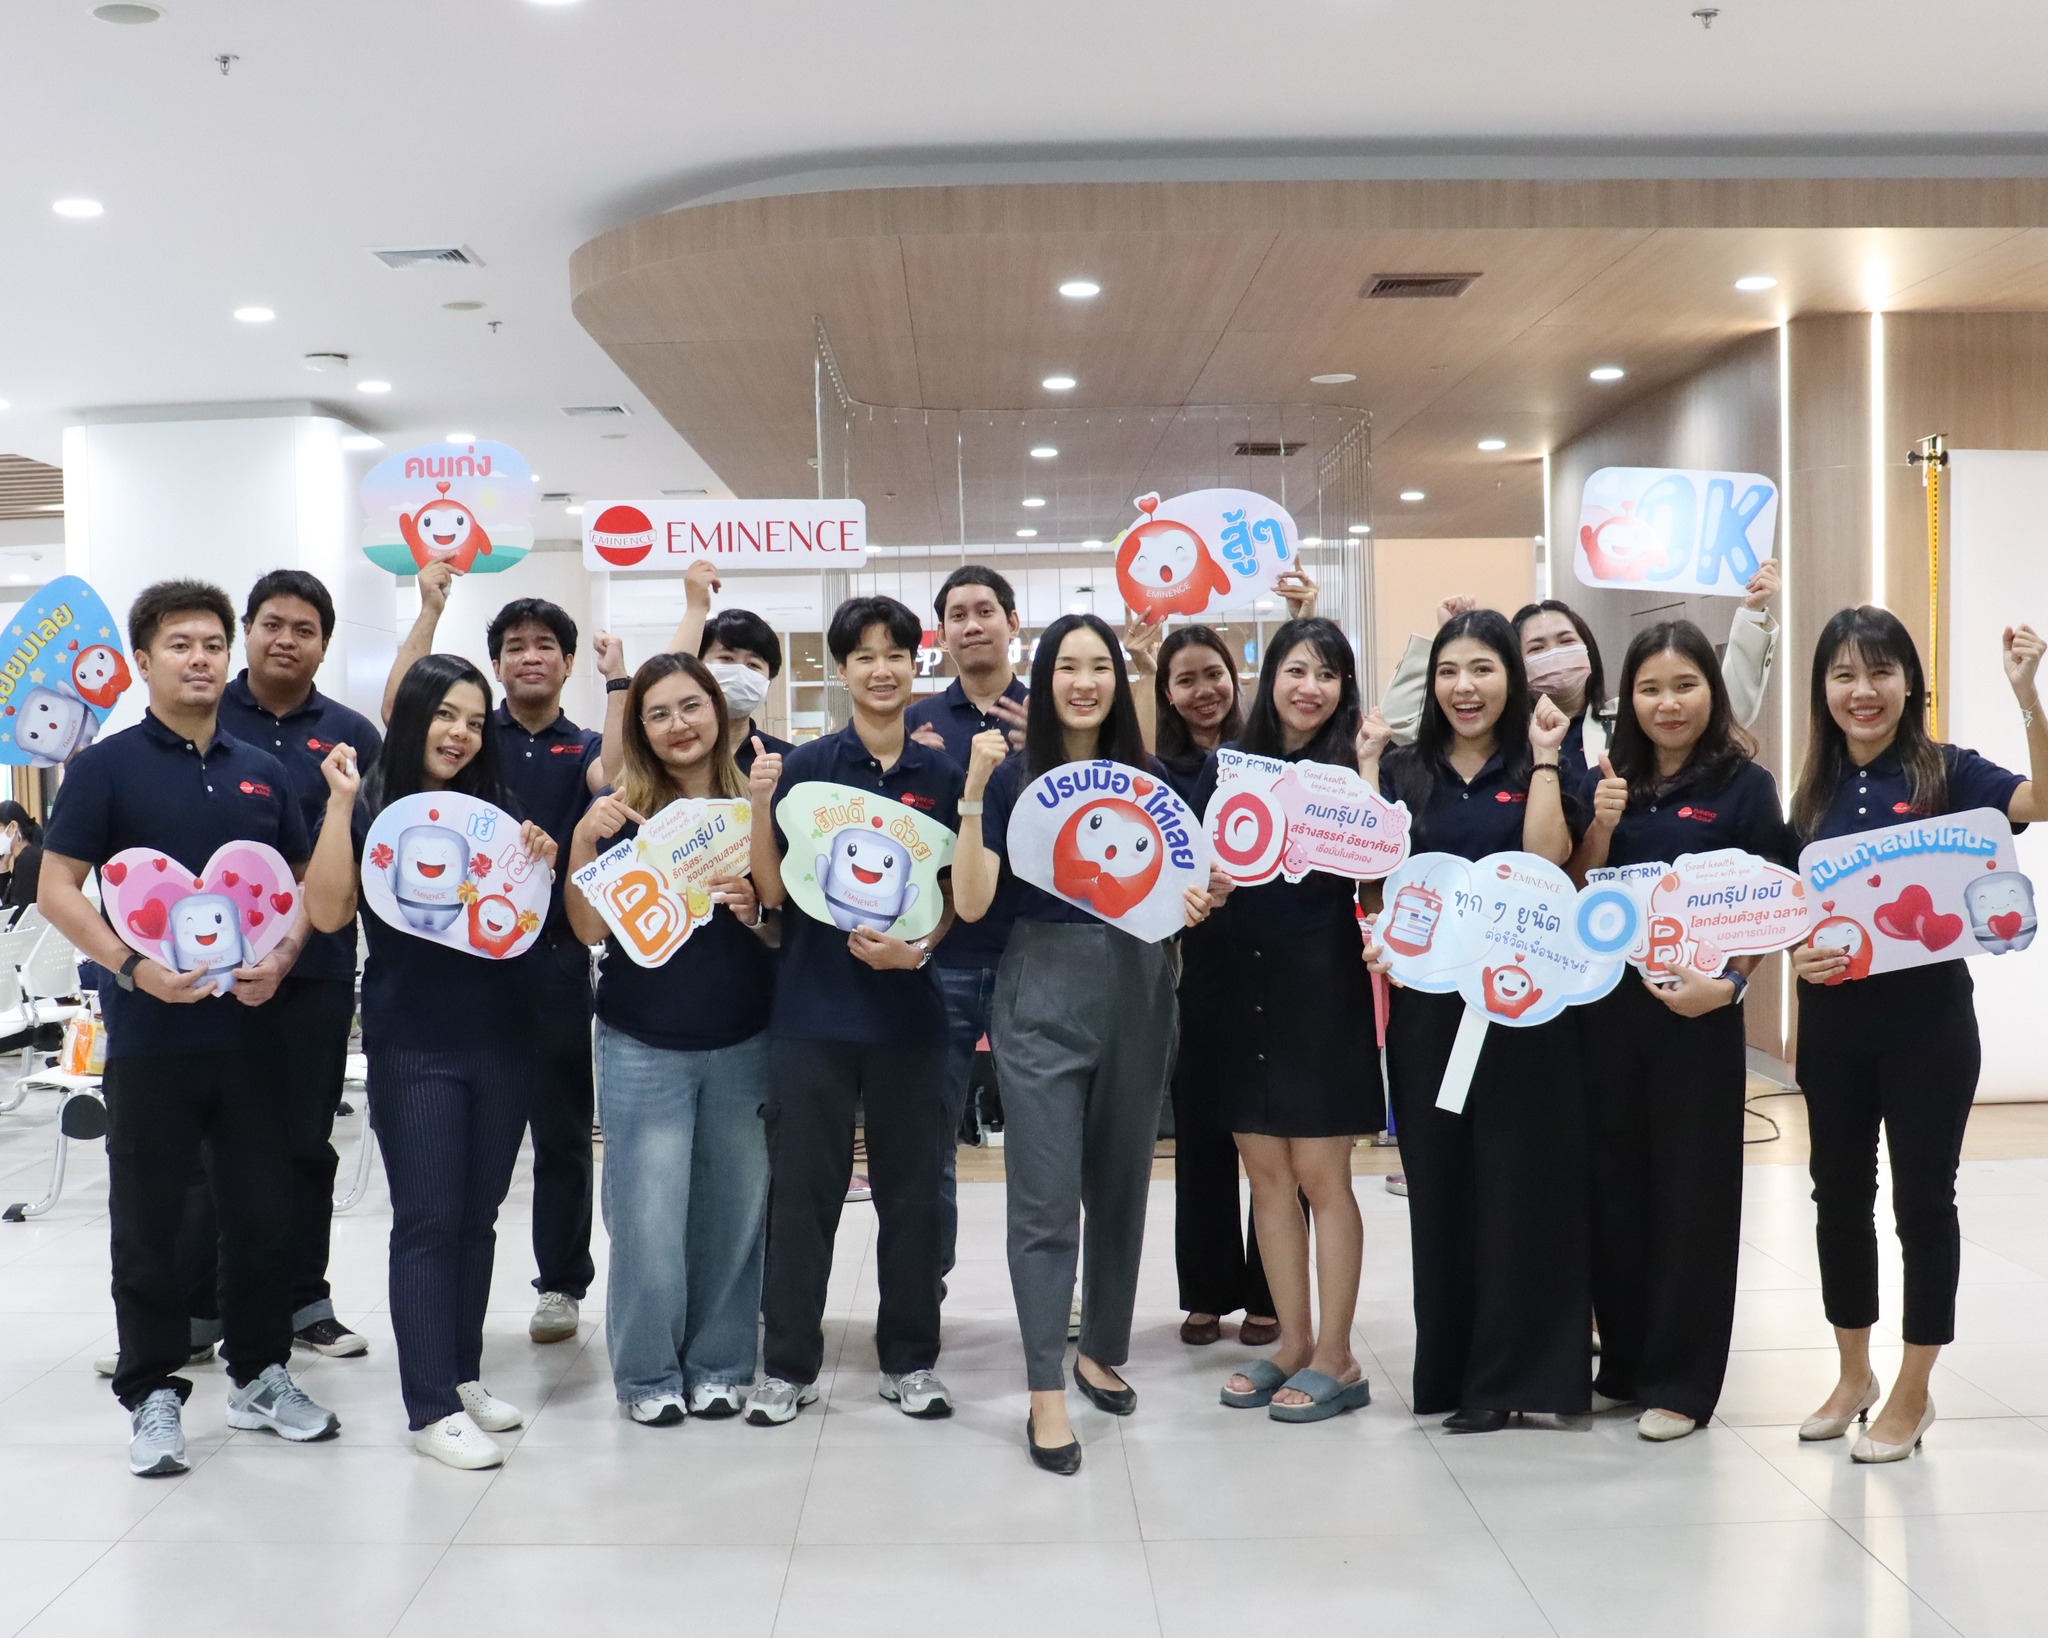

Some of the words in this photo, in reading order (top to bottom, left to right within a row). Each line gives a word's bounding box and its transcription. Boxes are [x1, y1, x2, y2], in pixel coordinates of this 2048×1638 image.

[405, 445, 492, 478] คนเก่ง
[591, 533, 654, 546] EMINENCE
[667, 520, 860, 553] EMINENCE
[1635, 474, 1774, 586] OK
[1146, 581, 1191, 599] EMINENCE
[1221, 753, 1243, 766] TOP
[1246, 759, 1283, 775] FORM
[813, 797, 866, 834] ยินดี
[890, 815, 932, 863] ด้วย
[1036, 759, 1130, 809] ปรบมือ
[1144, 785, 1195, 870] ให้เลย
[1304, 803, 1360, 829] คนกรุ๊ป
[1361, 809, 1378, 829] โอ
[671, 823, 714, 864] คนกรุ๊ป
[714, 813, 727, 834] บี
[1290, 822, 1347, 843] สร้างสรรค์
[1346, 833, 1401, 855] อัธยาศัยดี
[576, 867, 597, 885] TOP
[600, 843, 633, 871] FORM
[1590, 871, 1616, 883] TOP
[1620, 865, 1662, 881] FORM
[1513, 871, 1563, 894] EMINENCE
[1687, 884, 1748, 909] คนกรุ๊ป
[1752, 880, 1783, 901] เอบี
[843, 889, 880, 908] EMINENCE
[1454, 889, 1484, 918] ทุก
[1516, 903, 1561, 934] ยูนิต
[1690, 910, 1770, 928] โลกส่วนตัวสูง
[1773, 906, 1808, 920] ฉลาด
